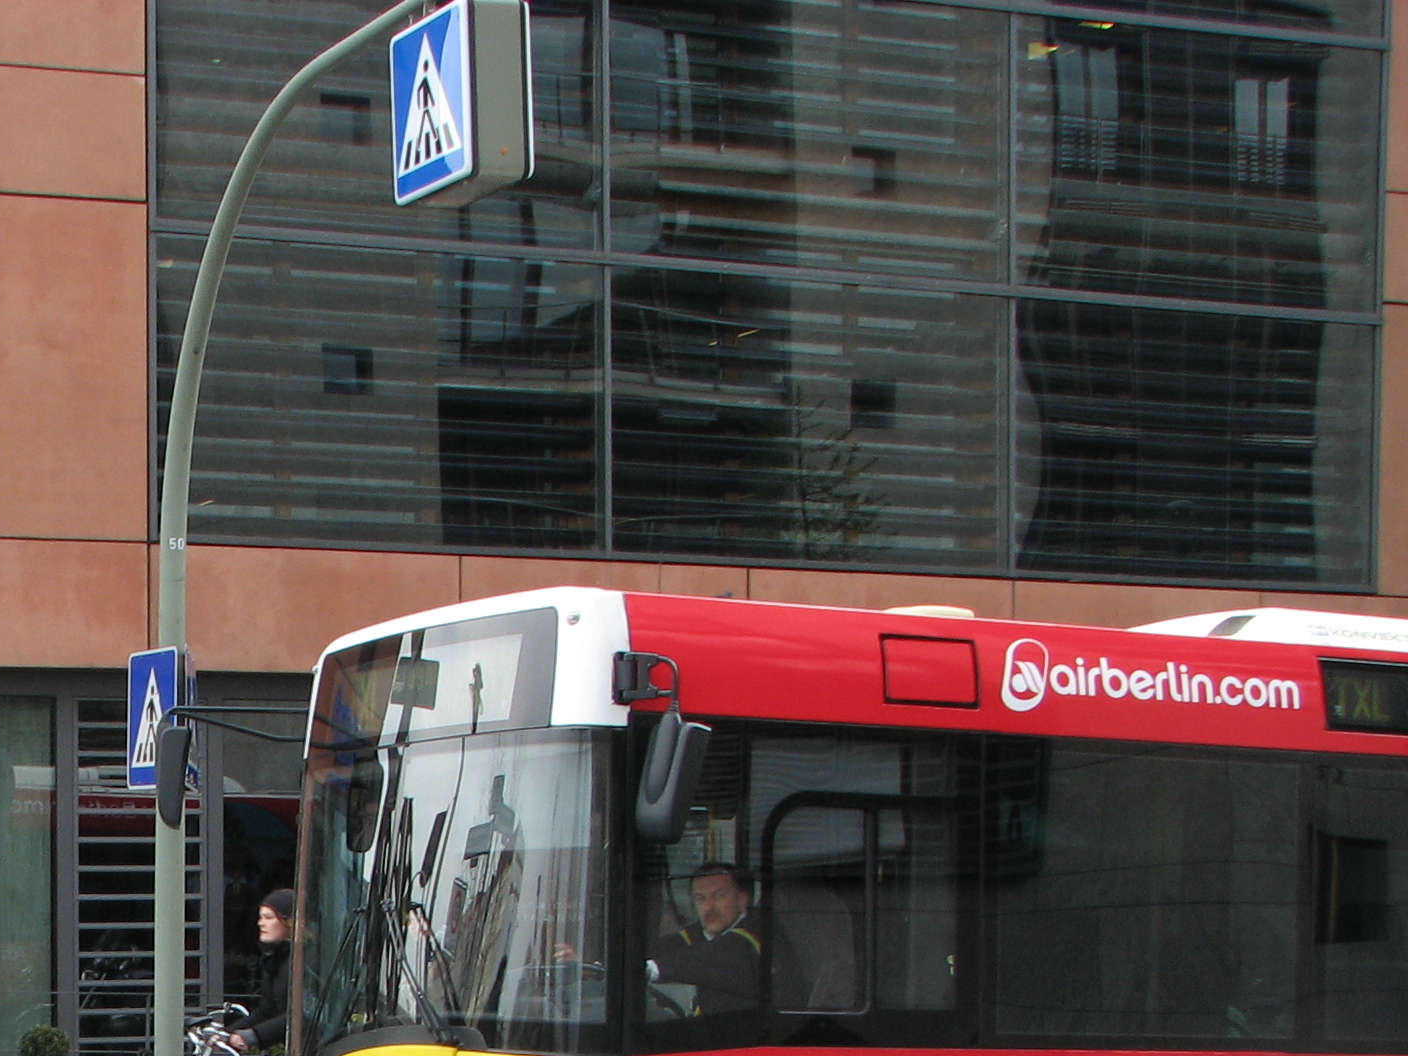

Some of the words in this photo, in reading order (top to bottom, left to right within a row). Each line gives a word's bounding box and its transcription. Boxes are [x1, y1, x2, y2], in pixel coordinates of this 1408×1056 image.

[169, 537, 185, 550] 50
[1050, 656, 1301, 710] airberlin.com
[1334, 677, 1390, 722] TXL
